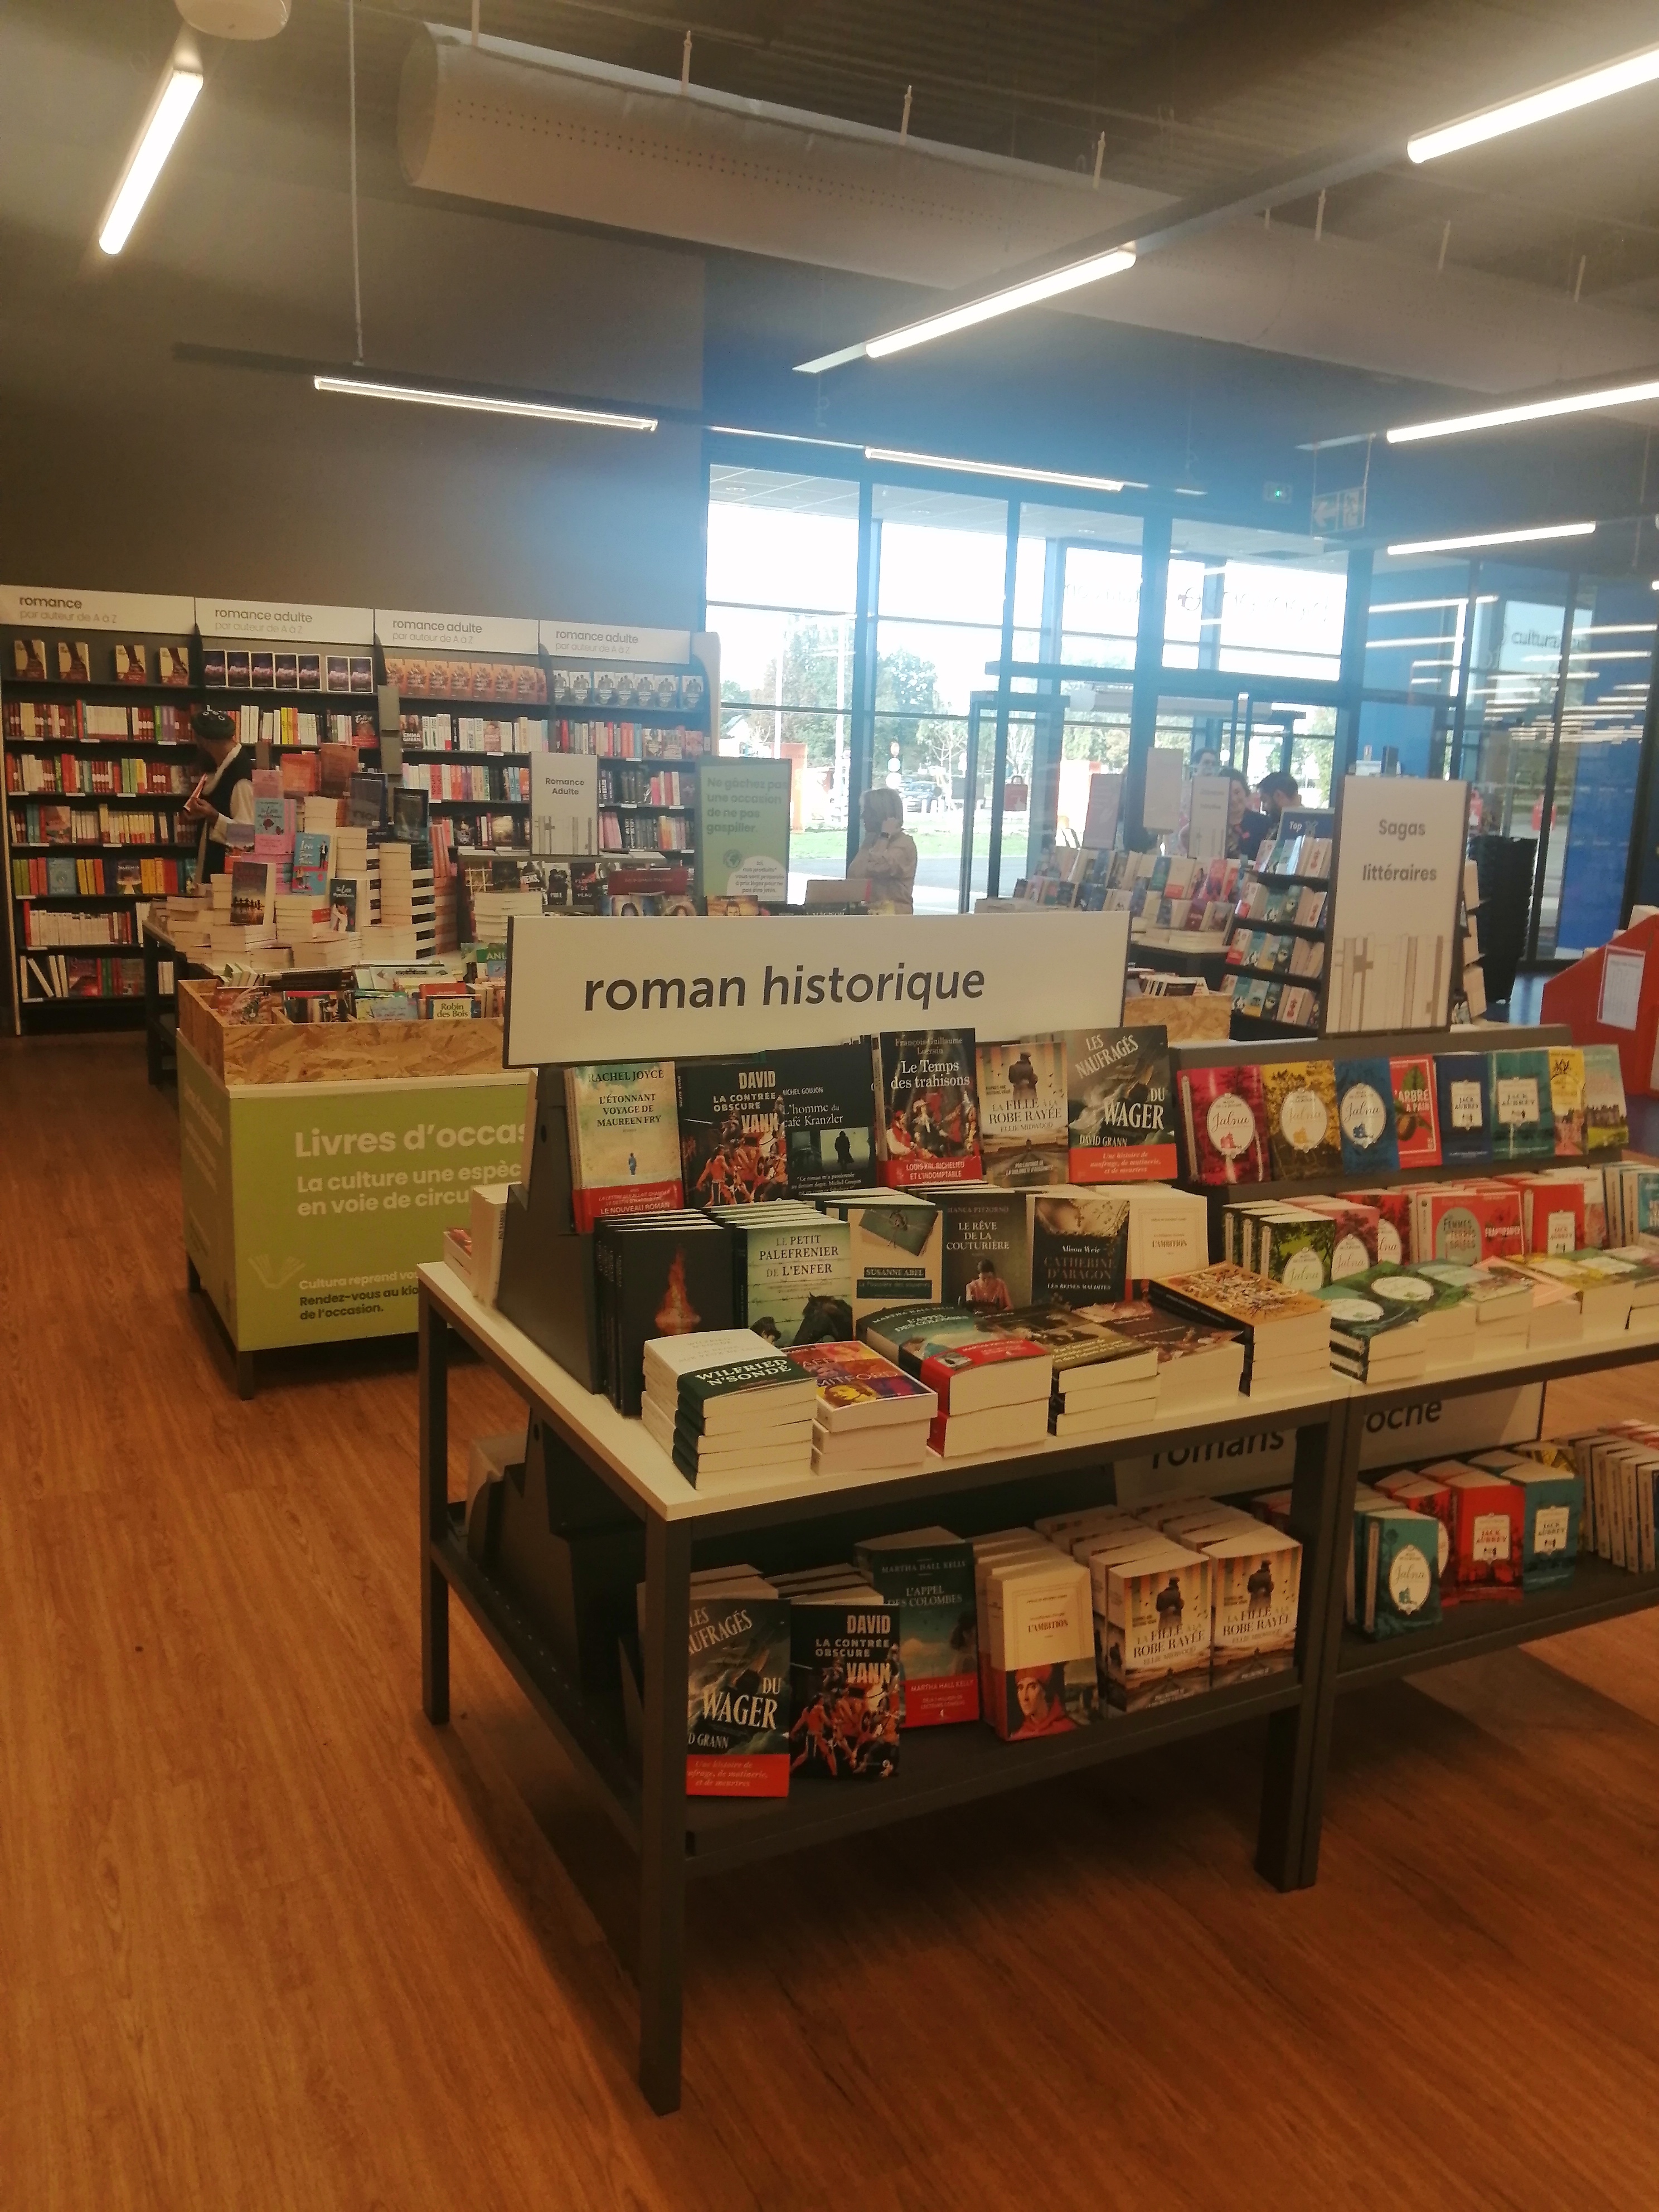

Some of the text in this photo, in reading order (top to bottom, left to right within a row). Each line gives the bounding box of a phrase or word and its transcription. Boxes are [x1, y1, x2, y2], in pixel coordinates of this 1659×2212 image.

[20, 596, 83, 609] romance
[20, 610, 37, 620] par
[41, 612, 74, 622] auteur
[76, 612, 90, 622] de
[215, 608, 312, 623] romance adulte
[216, 622, 231, 631] par
[233, 623, 264, 633] auteur
[267, 624, 279, 633] de
[392, 619, 482, 633] romance adulte
[392, 632, 408, 641] par
[410, 633, 438, 642] auteur
[440, 634, 452, 643] de
[556, 630, 639, 644] romance adulte
[556, 643, 570, 651] par
[571, 644, 597, 652] auteur
[600, 644, 609, 653] de
[545, 778, 585, 786] Romance
[707, 777, 788, 792] Ne gâchez pas
[552, 787, 579, 795] Adulte
[707, 793, 781, 804] une occasion
[707, 807, 721, 817] de
[740, 809, 760, 821] pas
[706, 822, 758, 835] gaspiller.
[1289, 821, 1302, 833] Top
[1379, 818, 1425, 841] Sagas
[1362, 863, 1437, 882] littéraires
[584, 962, 986, 1011] roman historique
[1086, 1034, 1104, 1051] LES
[917, 1046, 943, 1055] Lorrain
[1075, 1035, 1138, 1079] NAUFRAGÉS
[901, 1059, 959, 1074] Le Temps
[588, 1069, 664, 1083] RACHEL JOYCE
[739, 1070, 776, 1089] DAVID
[890, 1074, 970, 1089] des trahisons
[713, 1095, 726, 1104] LA
[1149, 1088, 1165, 1103] DU
[1394, 1089, 1429, 1103] 'ARBRE
[1458, 1095, 1475, 1104] JACK
[603, 1104, 654, 1115] VOYAGE DE
[714, 1102, 761, 1112] OBSCURE
[1006, 1098, 1039, 1110] FILLE
[989, 1106, 1062, 1124] ROBE RAYÉE
[1104, 1102, 1165, 1130] WAGER
[1343, 1101, 1381, 1122] Jalna
[596, 1115, 662, 1128] MAUREEN FRY
[741, 1113, 779, 1134] VANN
[804, 1113, 843, 1126] Kranzler
[1211, 1110, 1250, 1132] Jalna
[294, 1127, 396, 1158] Livres
[1079, 1133, 1128, 1147] DAVID GRANN
[298, 1175, 323, 1193] La
[327, 1168, 408, 1191] culture
[413, 1165, 454, 1185] une
[298, 1187, 470, 1216] en voie de circu
[610, 1204, 643, 1214] NOUVEAU
[645, 1201, 670, 1210] ROMAN
[958, 1220, 997, 1230] LE RÊVE
[776, 1235, 821, 1246] LE PETIT
[964, 1231, 992, 1240] DE LA
[946, 1239, 1010, 1250] COUTURIÈRE
[1062, 1244, 1082, 1253] Alison
[759, 1246, 838, 1260] PALEFRENIER
[767, 1263, 832, 1277] DE L'ENFER
[1044, 1257, 1115, 1269] CATHERINE
[1333, 1253, 1364, 1274] Jalna
[299, 1278, 347, 1290] Cultura
[348, 1271, 397, 1287] reprend
[1047, 1268, 1112, 1279] D'ARAGON
[1287, 1267, 1319, 1287] Jalna
[299, 1289, 381, 1306] Rendez-vous
[383, 1288, 399, 1297] au
[300, 1303, 384, 1320] de l'occasion.
[695, 1357, 788, 1381] WILFRIED
[707, 1363, 792, 1387] N'SONDÉ
[817, 1370, 898, 1387] MITFORD
[882, 1560, 967, 1574] MARTHA HALL KELLY
[1395, 1564, 1425, 1584] Jalna
[906, 1585, 945, 1597] L'APPEL
[909, 1594, 963, 1607] COLOMBES
[690, 1607, 710, 1627] LES
[1241, 1605, 1272, 1621] FILLE
[847, 1614, 891, 1634] DAVID
[1223, 1623, 1254, 1636] ROBE
[1151, 1624, 1183, 1641] FILLE
[816, 1638, 831, 1647] LA
[816, 1647, 871, 1658] OBSCURE
[1133, 1642, 1165, 1658] ROBE
[846, 1662, 891, 1684] VANN
[762, 1677, 782, 1695] DU
[911, 1679, 974, 1692] MARTHA HALL KELLY
[702, 1687, 778, 1729] WAGER
[697, 1733, 729, 1749] GRANN
